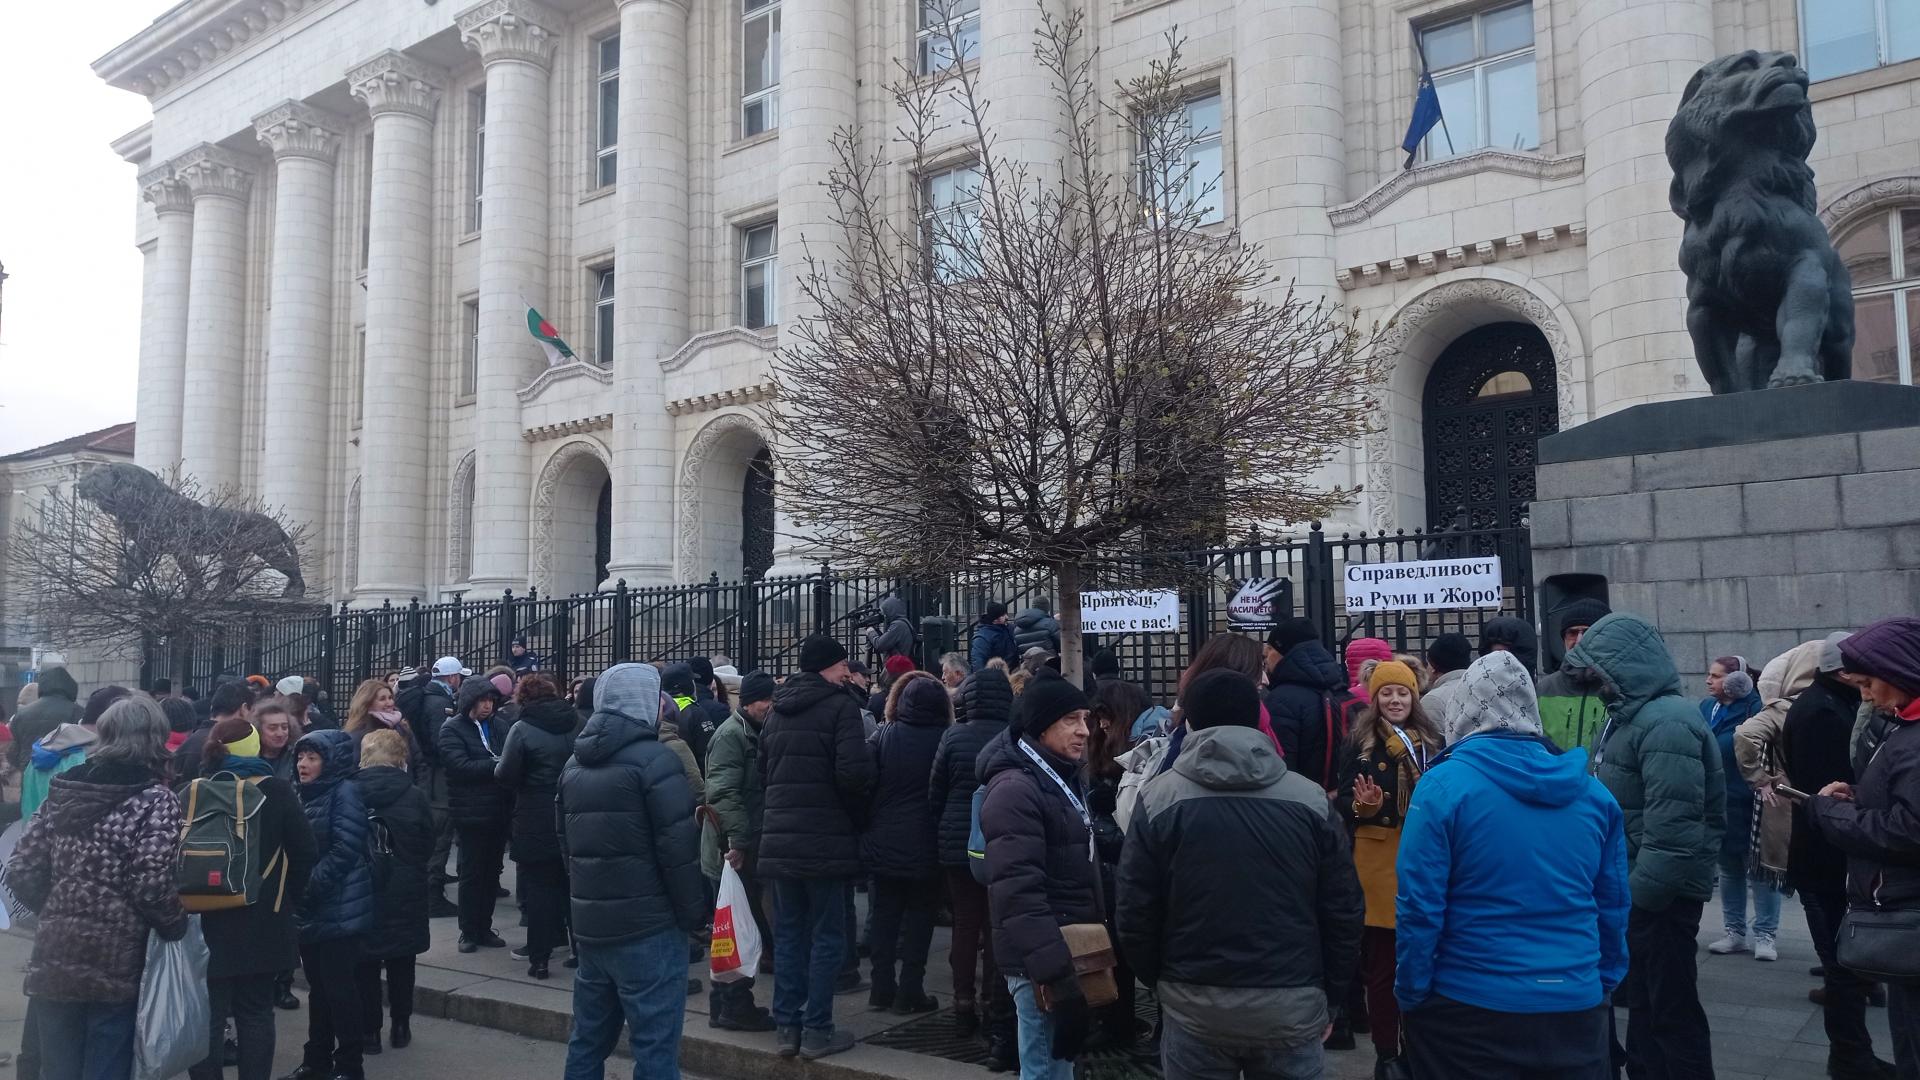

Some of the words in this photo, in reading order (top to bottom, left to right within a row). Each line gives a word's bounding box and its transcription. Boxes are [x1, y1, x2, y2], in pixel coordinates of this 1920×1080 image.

[1348, 562, 1494, 584] Справедливост
[1347, 595, 1364, 607] за
[1370, 591, 1417, 609] Руми
[1424, 592, 1434, 604] и
[1440, 586, 1501, 606] Жоро!
[1101, 620, 1125, 630] сме
[1130, 619, 1137, 629] с
[1142, 614, 1171, 629] вас!
